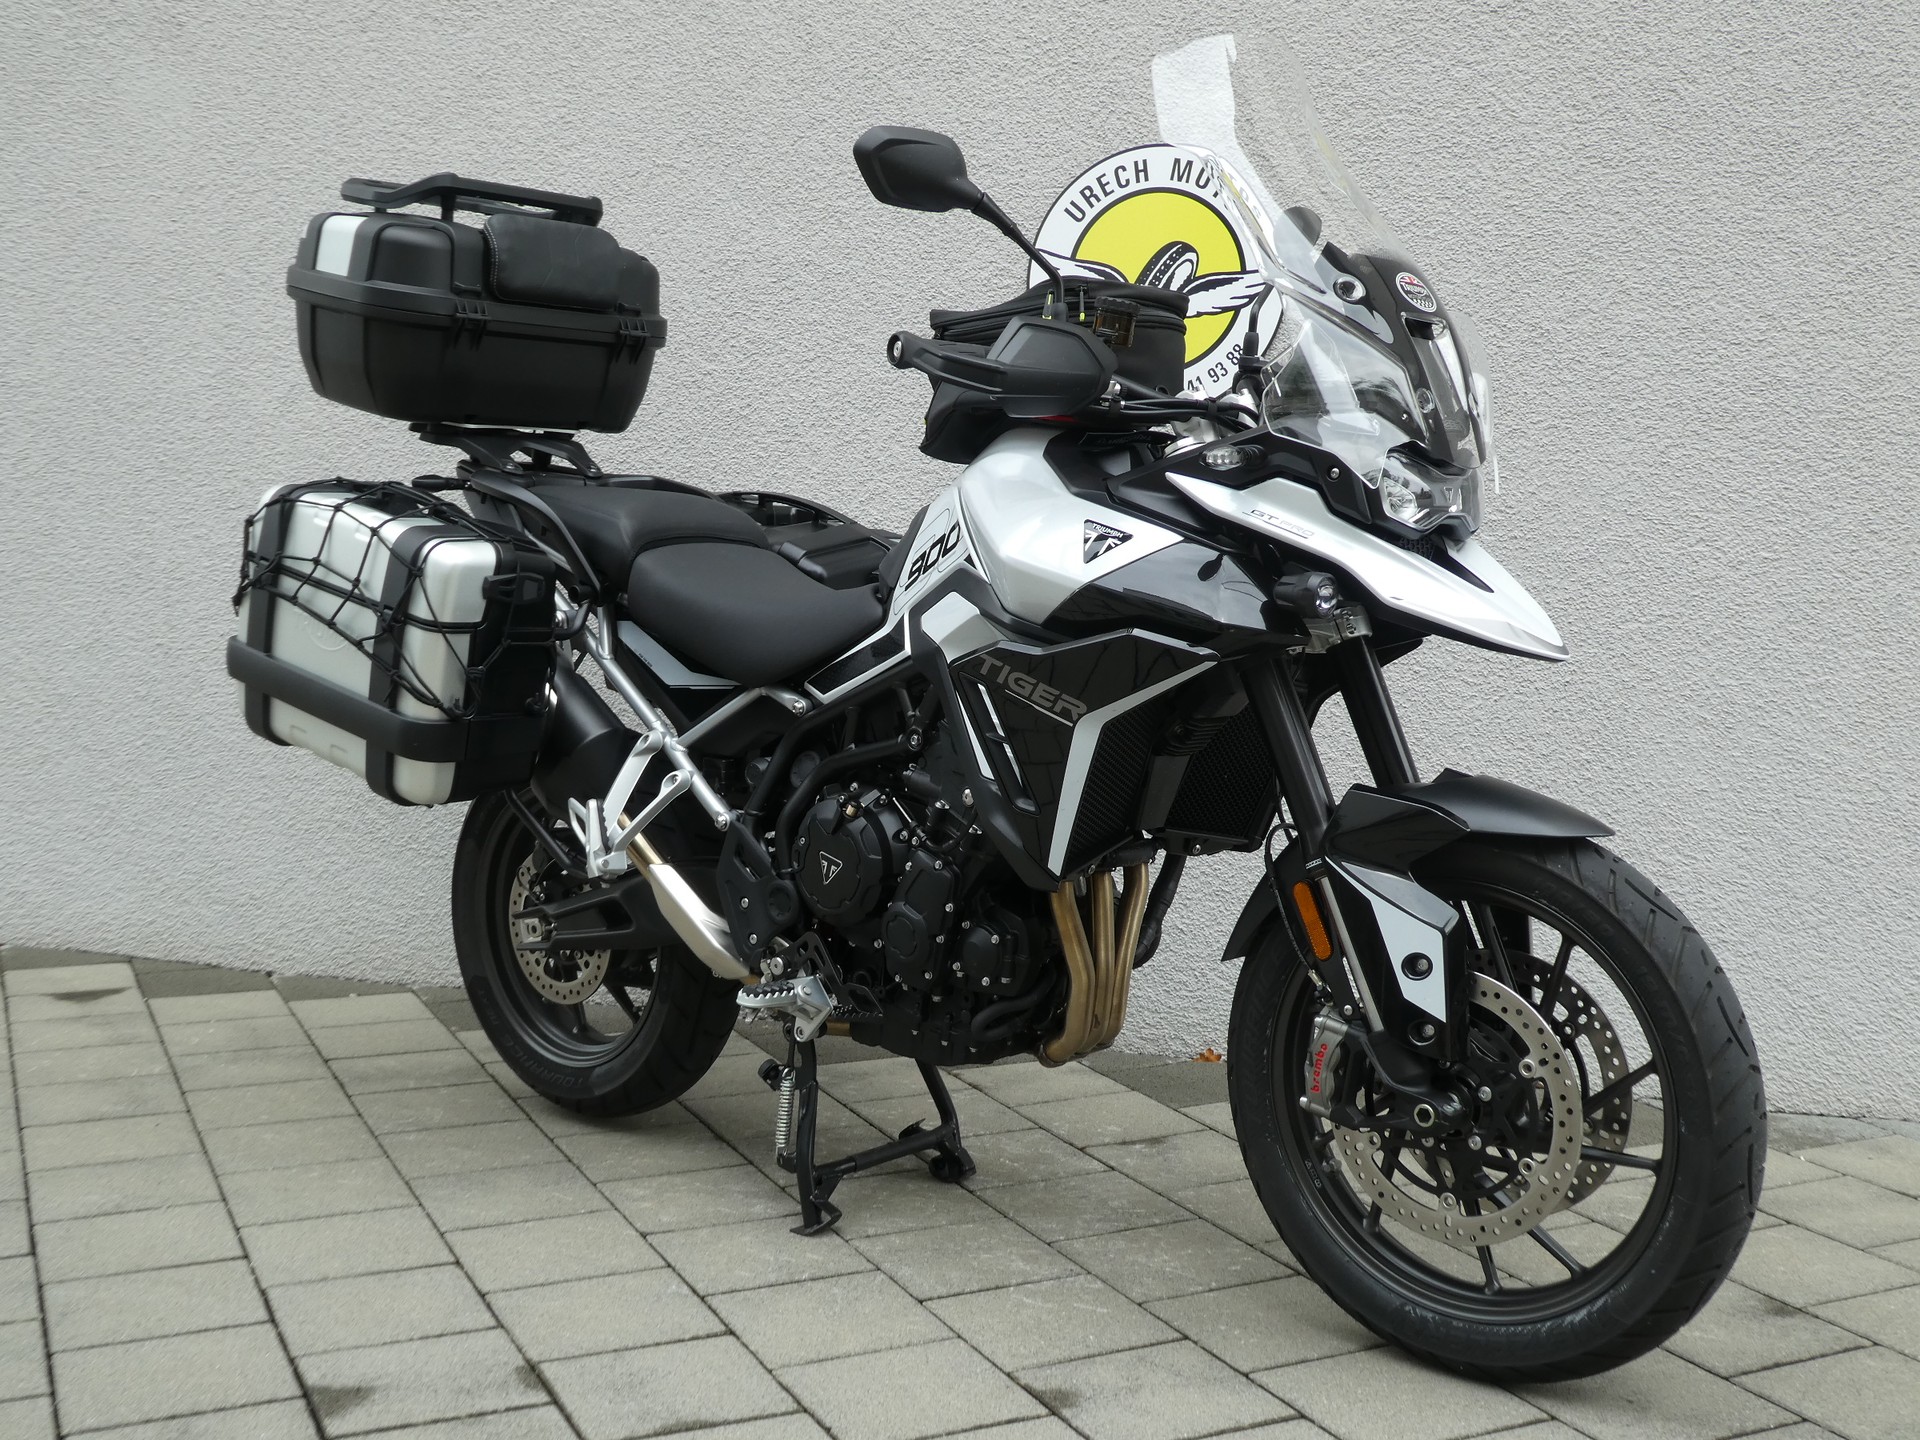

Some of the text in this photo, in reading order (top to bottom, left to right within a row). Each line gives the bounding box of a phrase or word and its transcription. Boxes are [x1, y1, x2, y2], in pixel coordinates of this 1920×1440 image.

[1064, 158, 1150, 223] URECH
[1207, 361, 1228, 383] 93
[1092, 522, 1124, 539] TRIUMPH
[1250, 509, 1315, 537] GT PRO
[904, 519, 961, 592] 900
[980, 653, 1088, 721] TIGER
[1310, 1043, 1328, 1093] brembo
